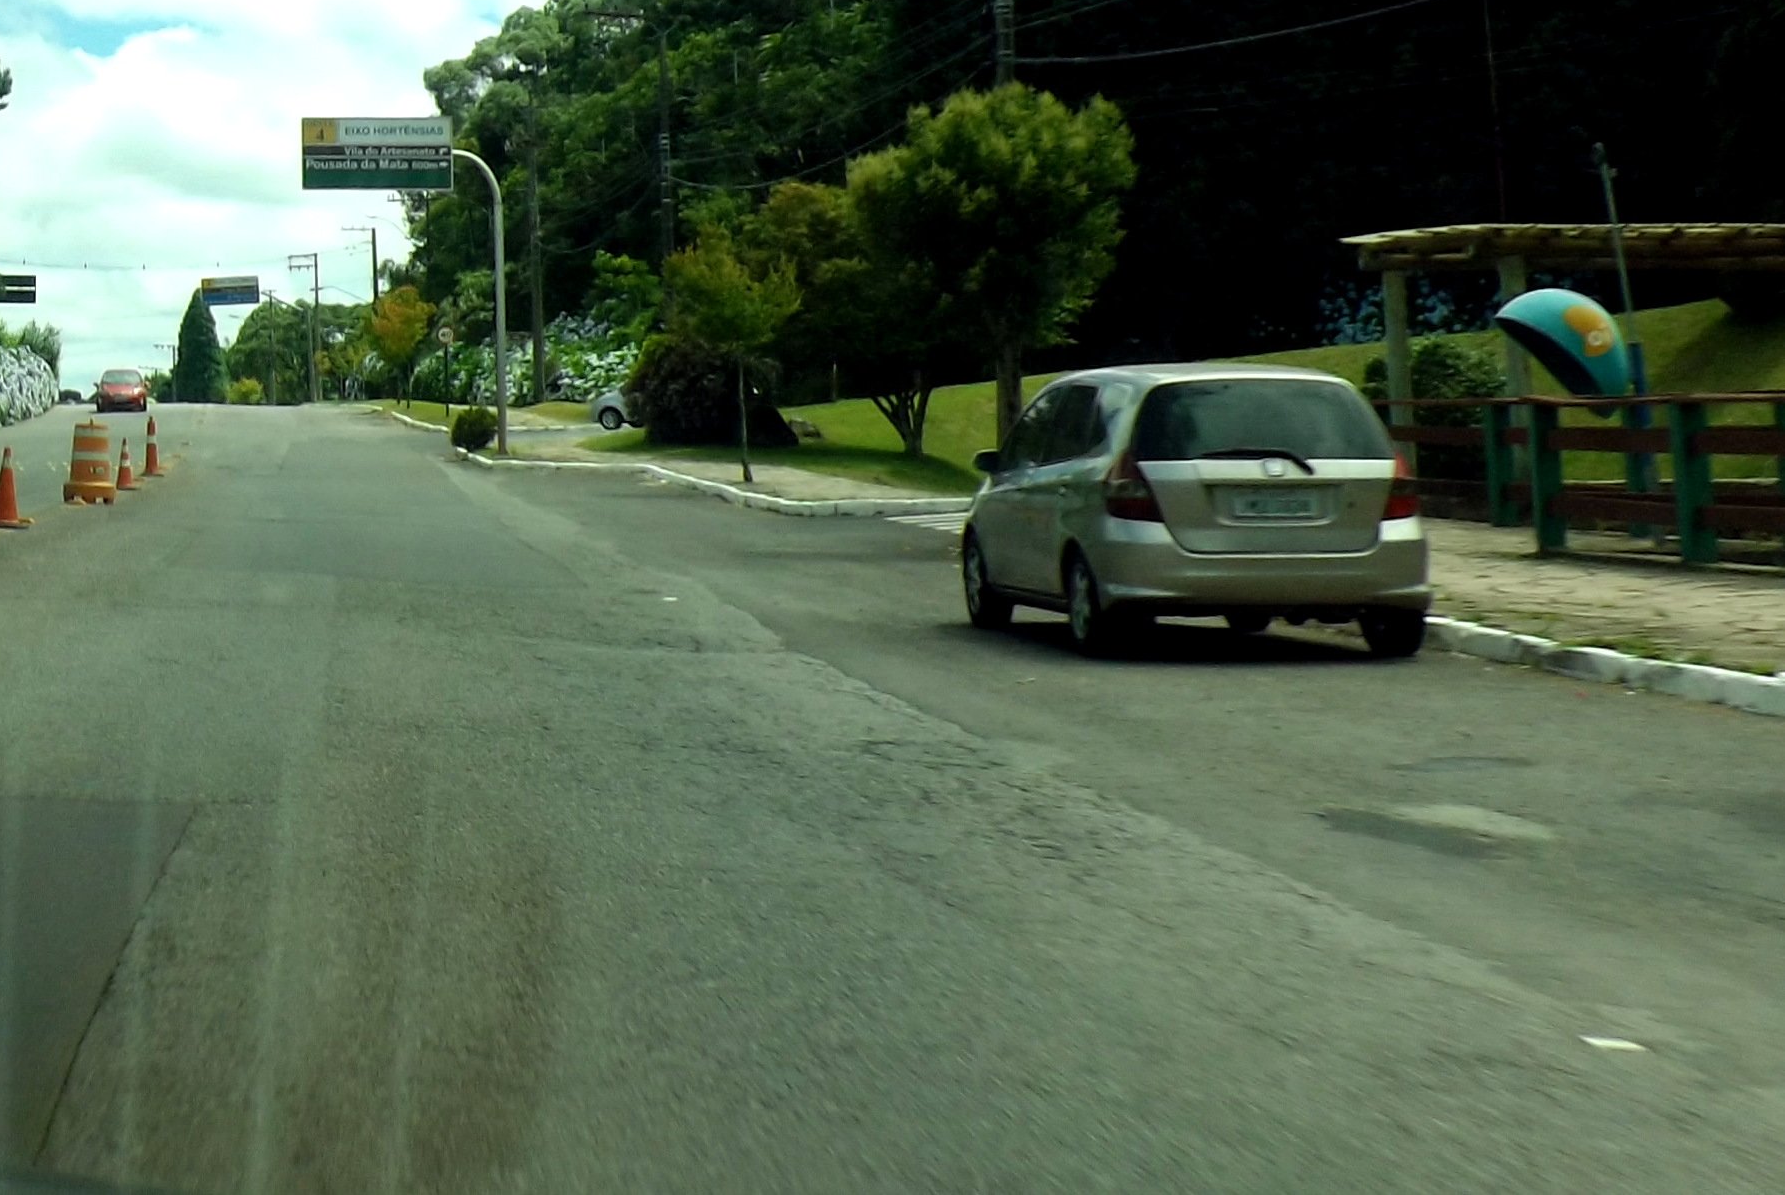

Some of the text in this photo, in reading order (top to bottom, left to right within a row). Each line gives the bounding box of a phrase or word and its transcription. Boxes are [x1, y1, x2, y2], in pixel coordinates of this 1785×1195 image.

[344, 124, 444, 136] EIXO HORTÊNSIAS
[344, 146, 436, 156] Vila do Artesanato
[306, 158, 358, 170] Pousada
[360, 158, 376, 170] da
[379, 158, 409, 170] Mata
